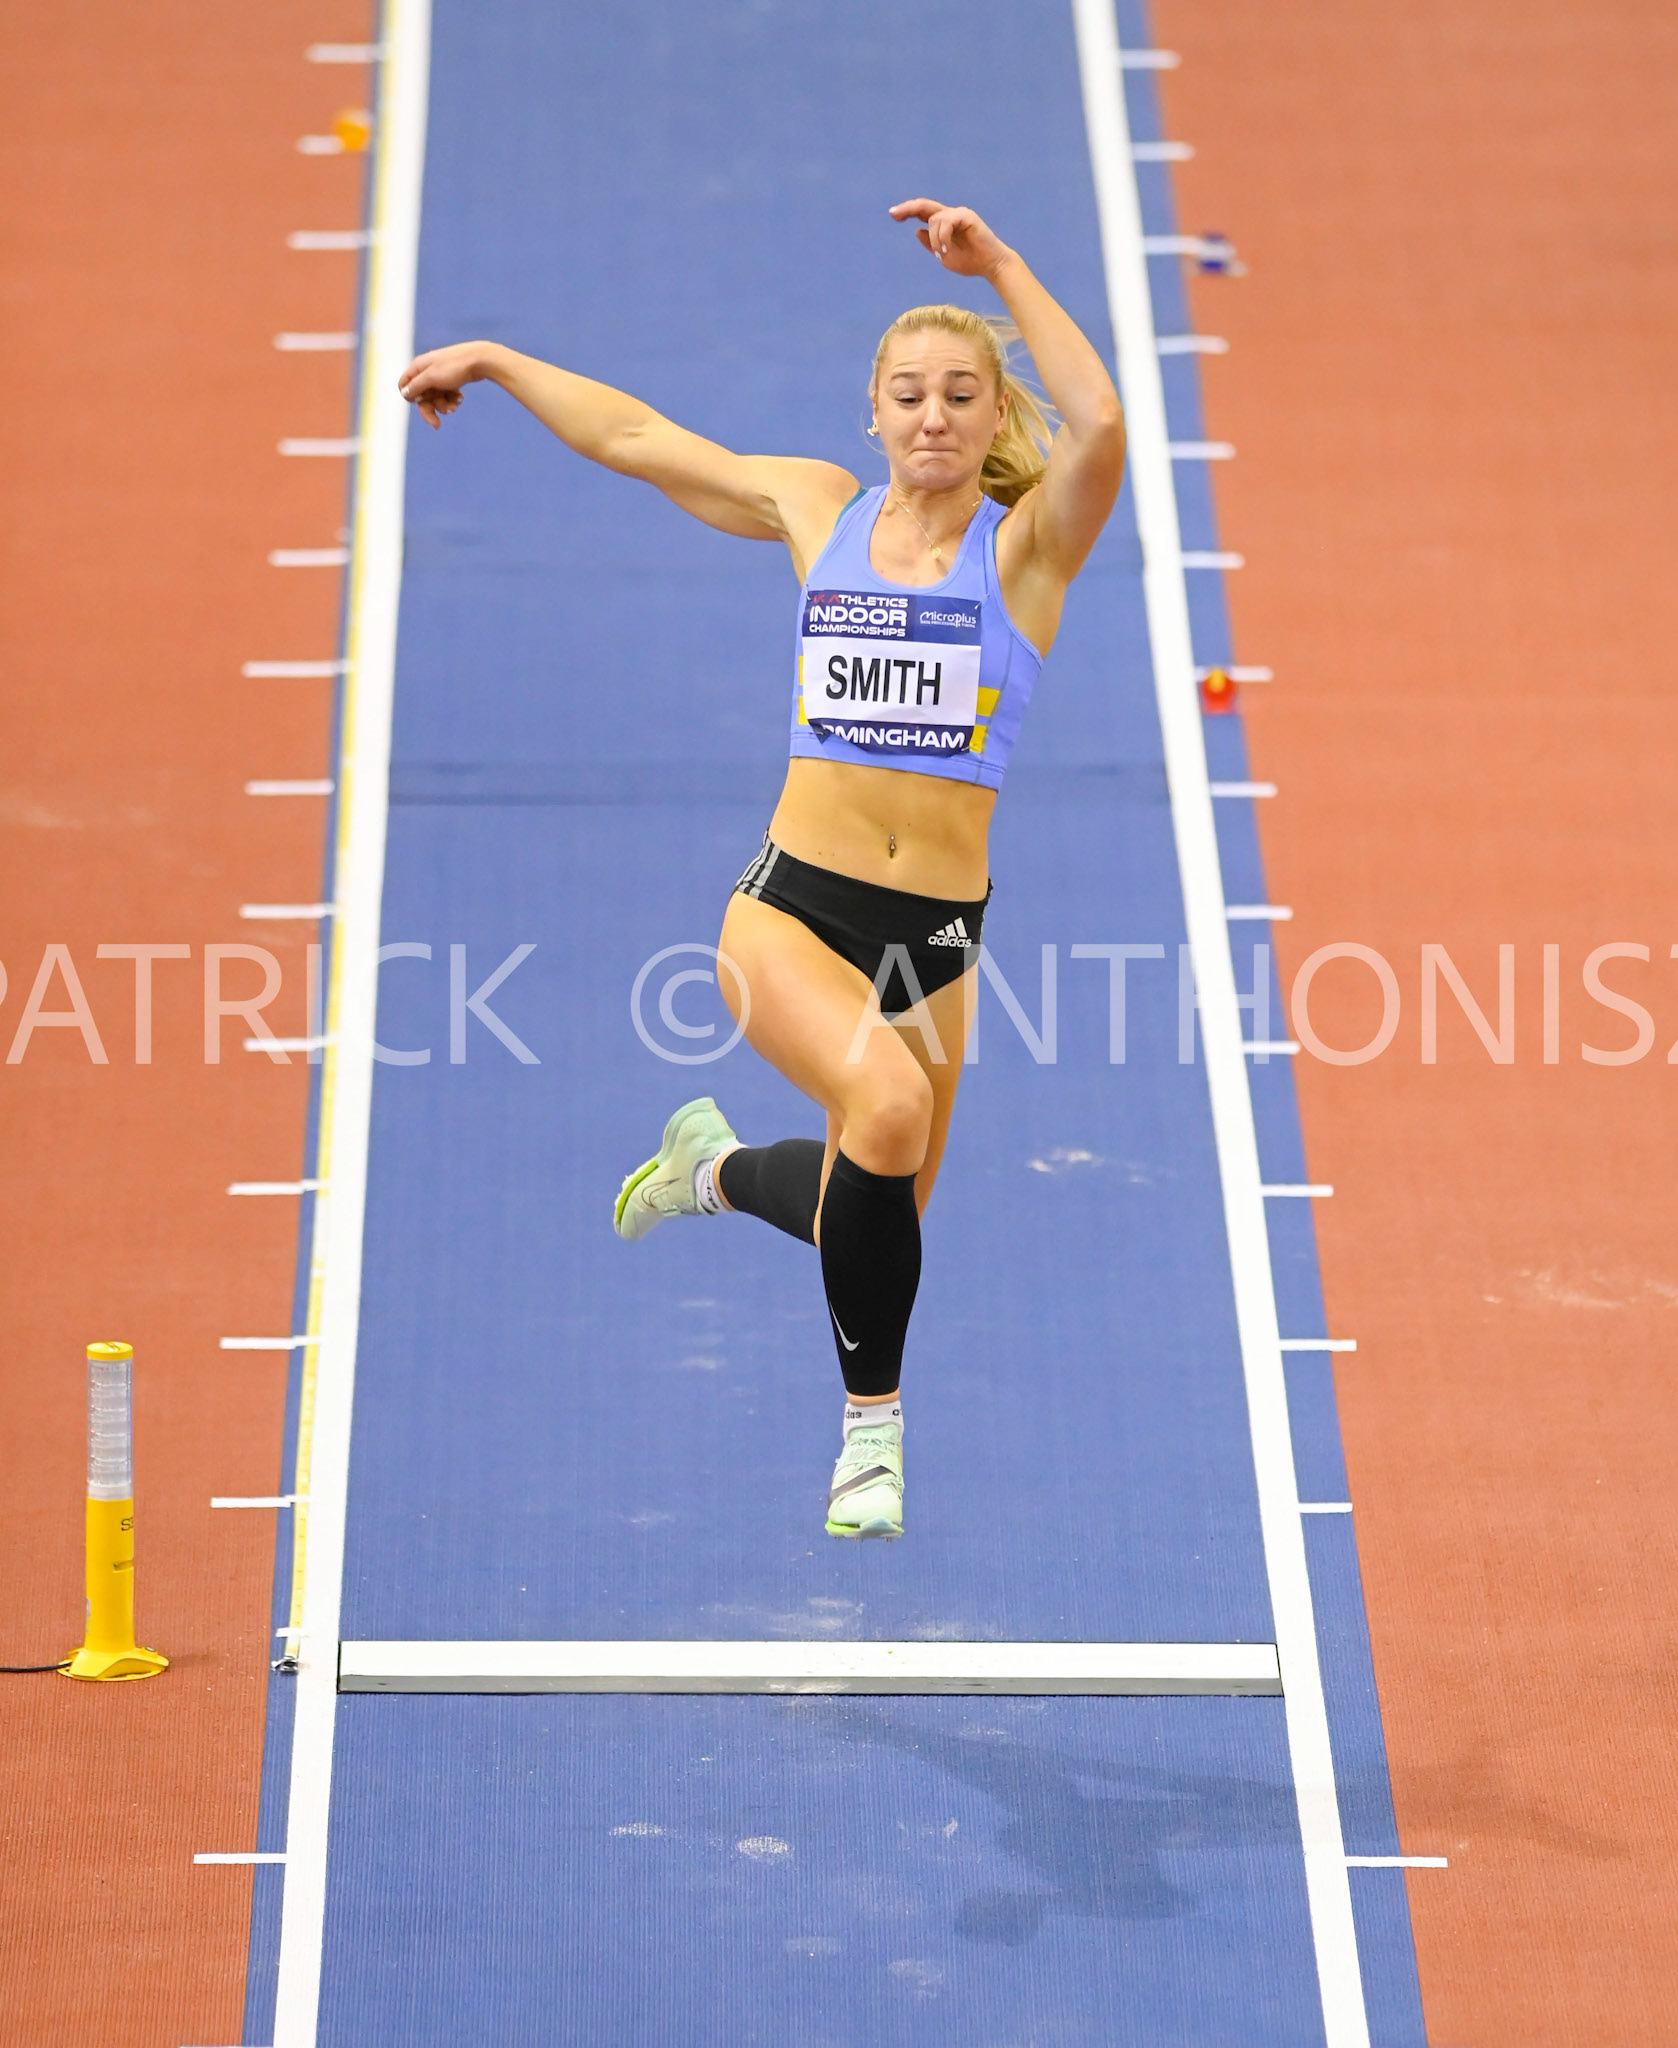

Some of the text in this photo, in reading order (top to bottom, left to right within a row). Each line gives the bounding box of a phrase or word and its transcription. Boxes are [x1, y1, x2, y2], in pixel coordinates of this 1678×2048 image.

[809, 605, 907, 627] INDOOR
[920, 611, 977, 628] Microplus
[809, 624, 906, 637] CHAMPIONSHIPS
[825, 655, 942, 706] SMITH
[927, 935, 973, 948] adidas
